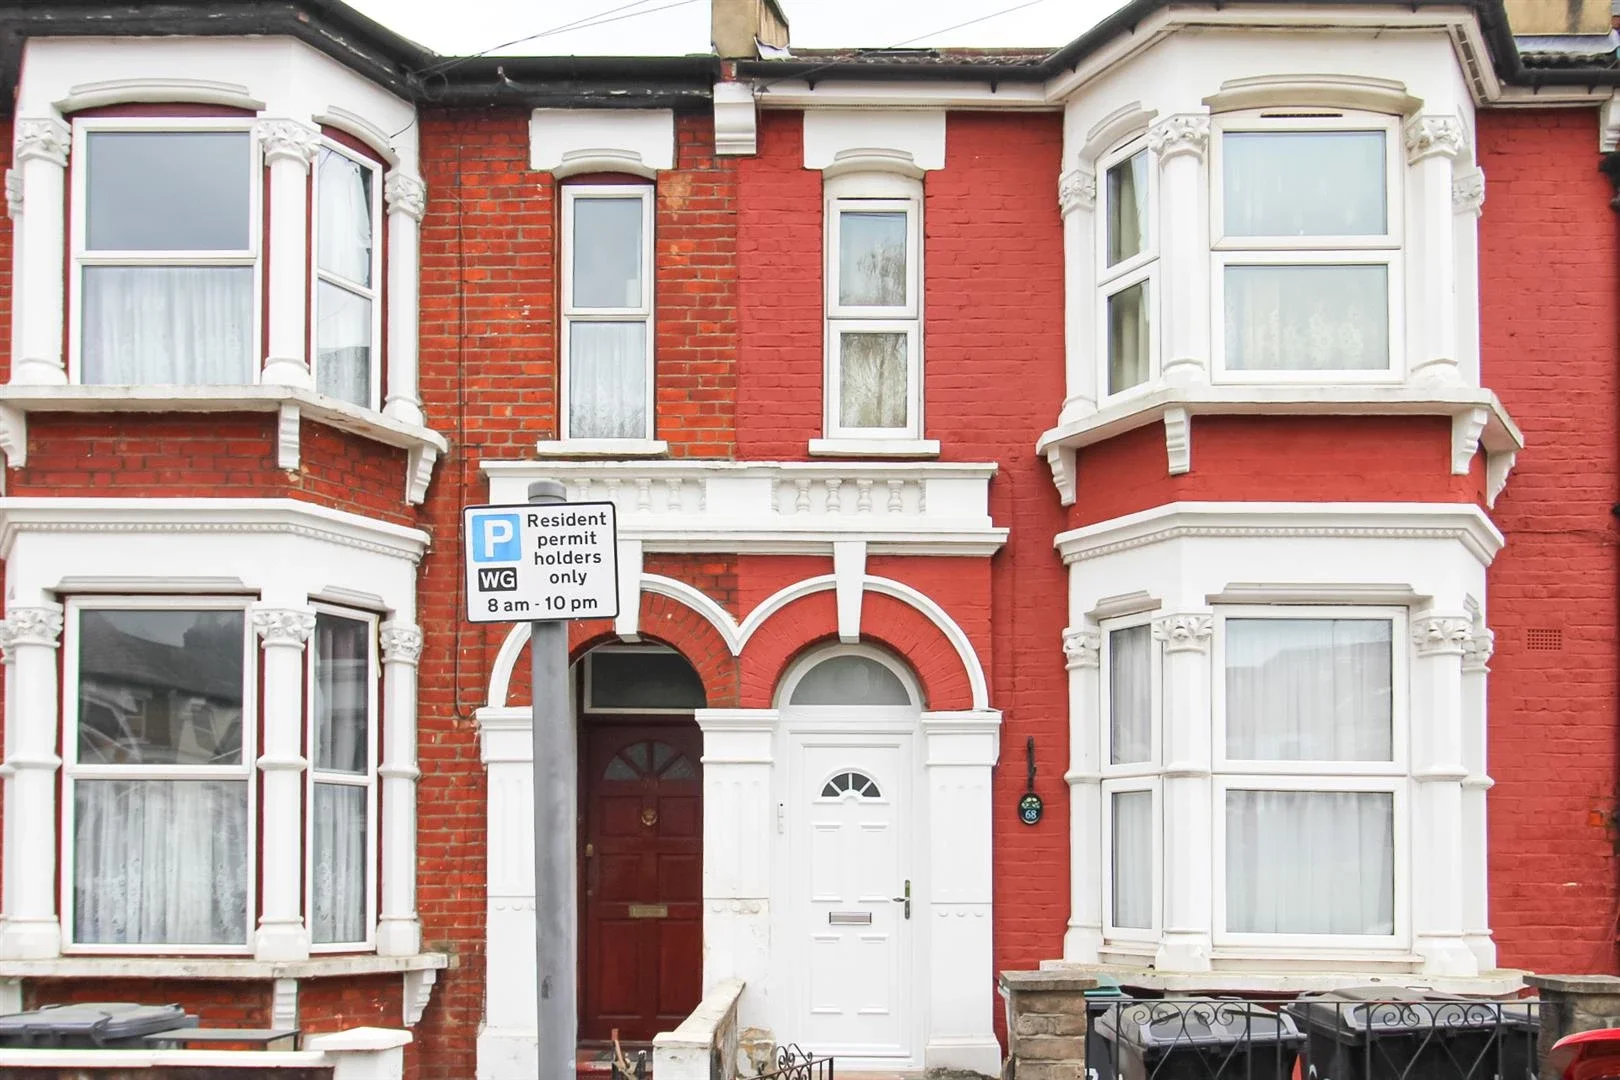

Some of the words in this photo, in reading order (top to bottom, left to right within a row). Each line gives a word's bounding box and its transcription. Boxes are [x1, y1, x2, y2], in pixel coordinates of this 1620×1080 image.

[528, 512, 607, 527] Resident
[484, 520, 513, 558] P
[537, 531, 597, 549] permit
[534, 551, 602, 566] holders
[480, 571, 515, 589] WG
[549, 570, 587, 586] only
[488, 599, 498, 613] 8
[504, 600, 530, 612] am
[545, 596, 566, 610] 10
[571, 597, 598, 612] pm
[1025, 810, 1037, 819] 68
